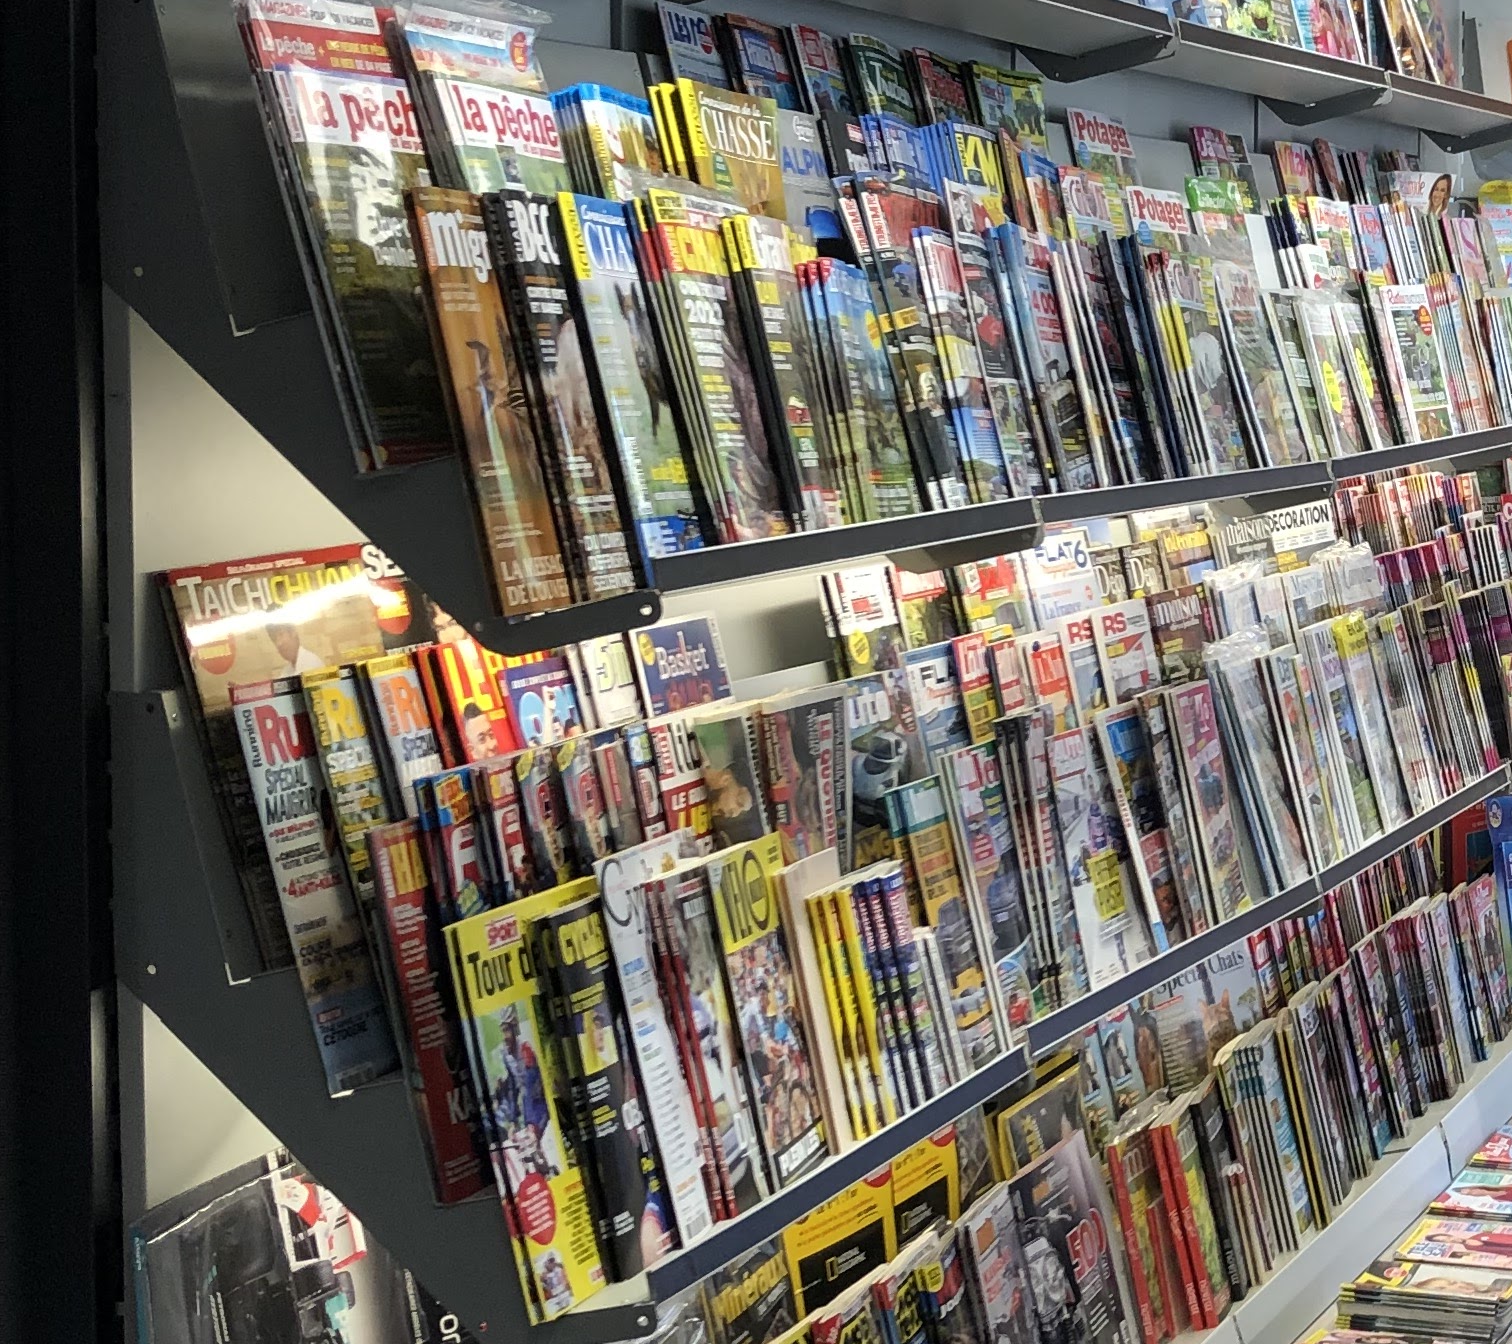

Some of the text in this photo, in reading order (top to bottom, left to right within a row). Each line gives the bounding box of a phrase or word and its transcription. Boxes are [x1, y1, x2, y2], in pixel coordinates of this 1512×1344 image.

[294, 75, 339, 128] la
[451, 85, 559, 157] la pêche
[702, 104, 778, 162] CHASSE
[1074, 115, 1131, 151] Potager
[1134, 192, 1186, 233] Potager
[1268, 503, 1330, 534] DECORATION
[1102, 612, 1127, 637] RS
[468, 942, 522, 1000] Tour
